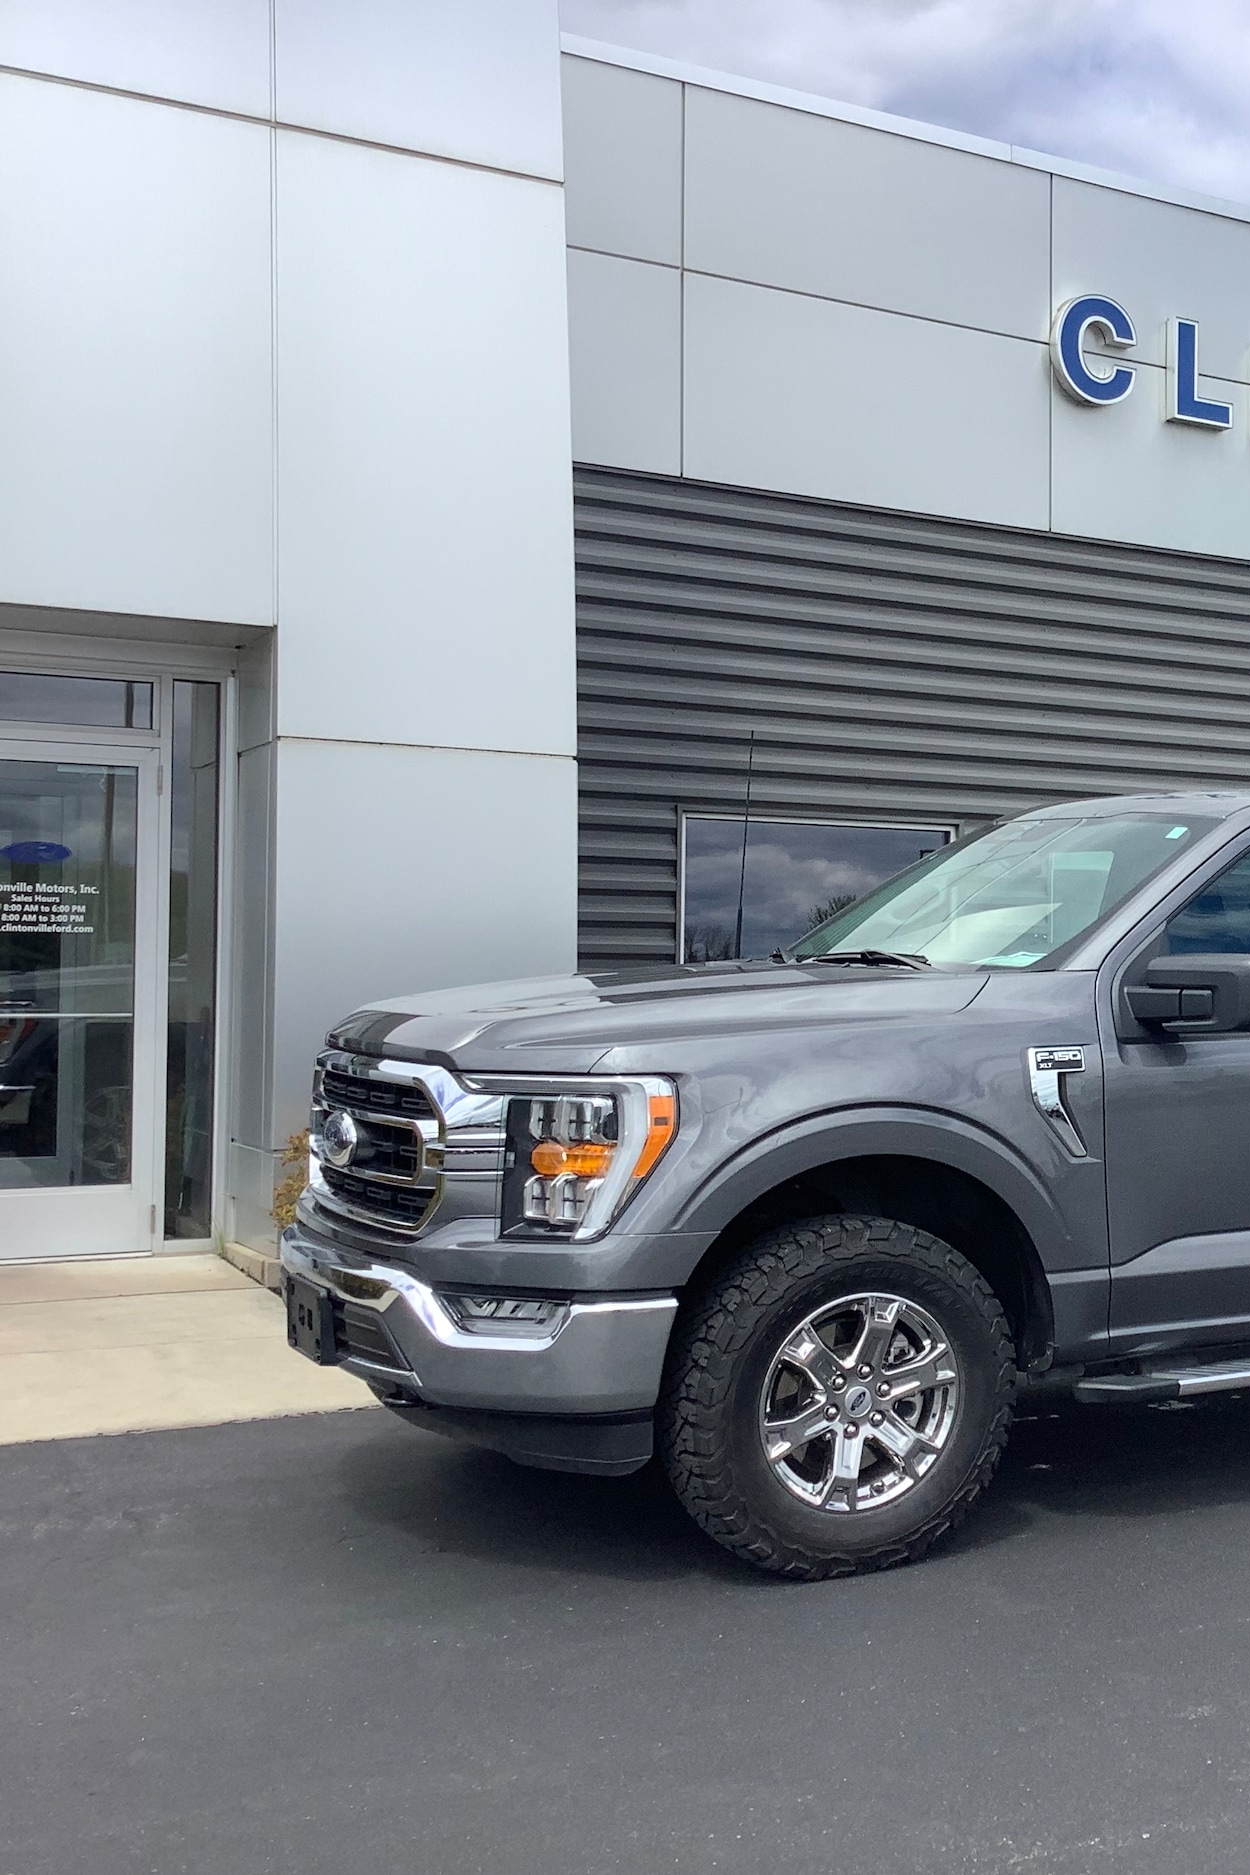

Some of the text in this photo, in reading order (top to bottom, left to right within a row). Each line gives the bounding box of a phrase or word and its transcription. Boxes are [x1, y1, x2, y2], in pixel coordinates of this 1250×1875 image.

[35, 883, 78, 895] Motors,
[80, 884, 100, 895] Inc.
[11, 893, 60, 903] Sales Hours
[3, 903, 23, 912] 8:00
[23, 904, 39, 912] AM
[40, 905, 50, 913] to
[52, 905, 71, 913] 6:00
[72, 905, 86, 913] PM
[1, 913, 84, 923] 8:00 AM to 3:00 PM
